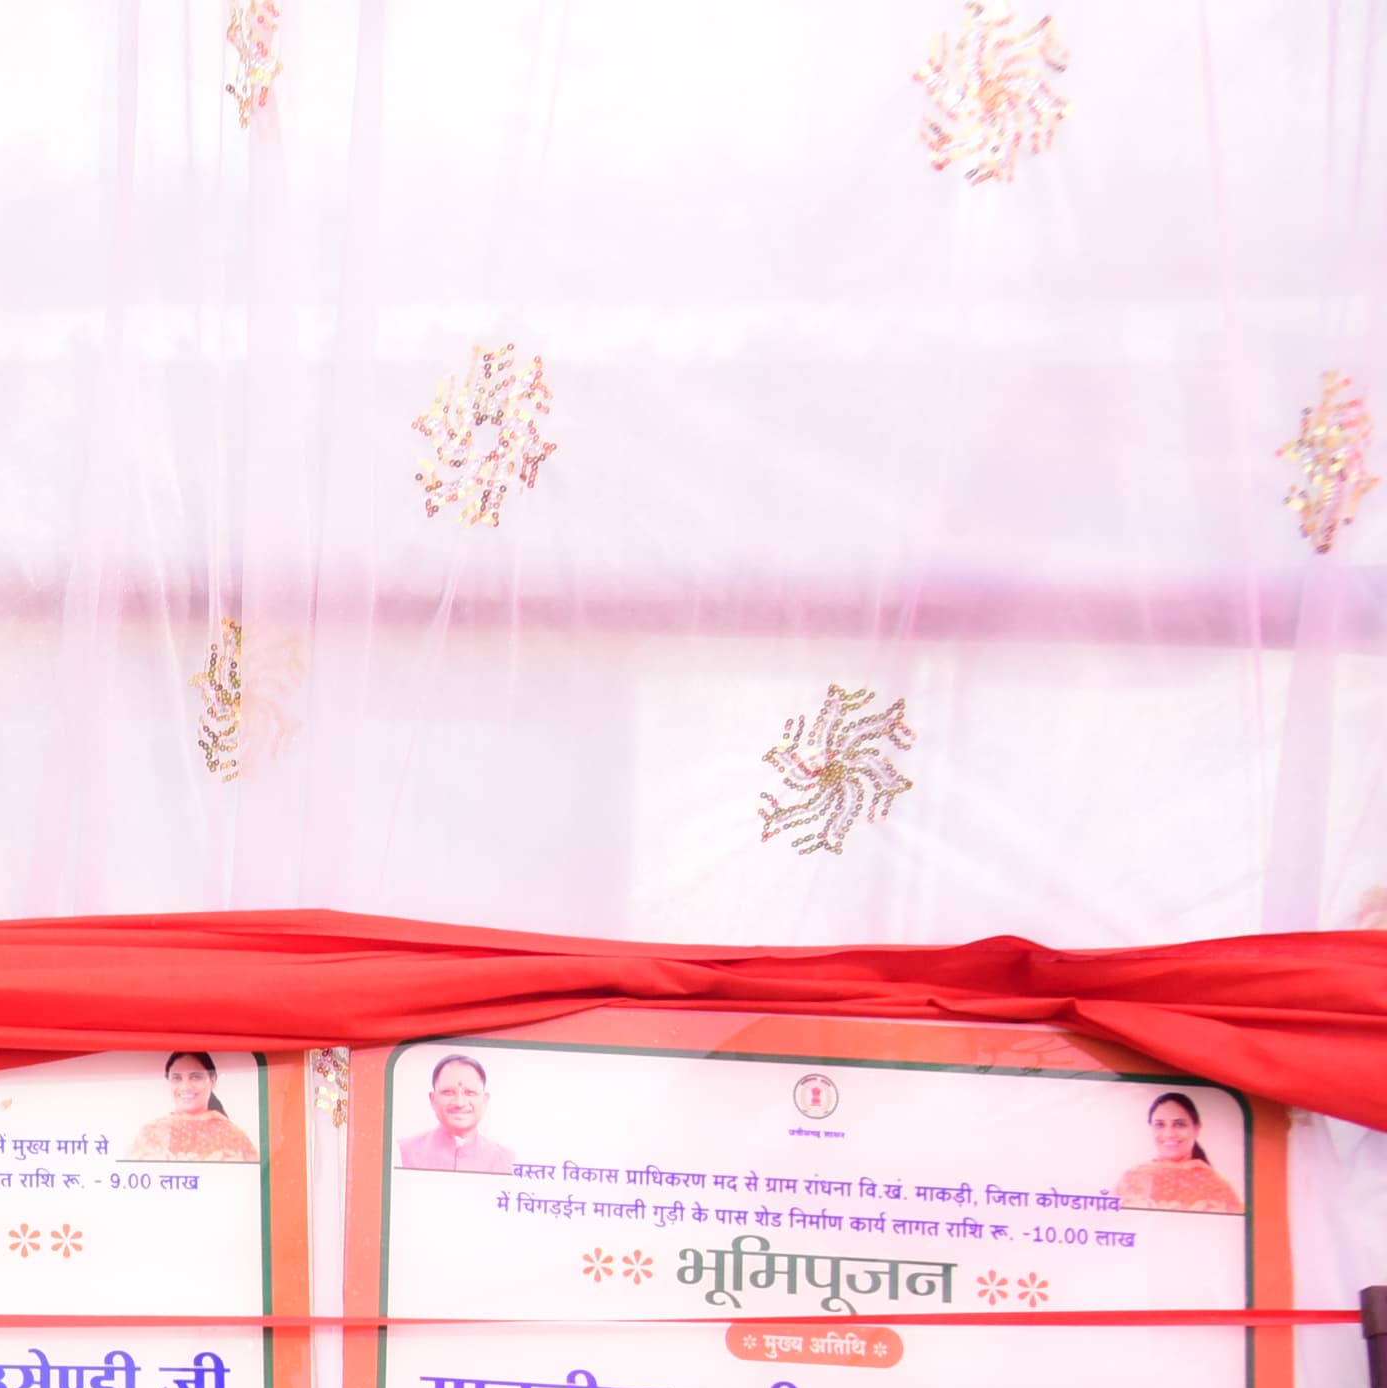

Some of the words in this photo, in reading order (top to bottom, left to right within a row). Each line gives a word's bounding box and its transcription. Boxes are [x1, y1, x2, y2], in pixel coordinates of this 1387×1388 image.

[561, 1160, 619, 1183] विकास
[624, 1164, 707, 1189] प्राधिकरण
[743, 1170, 759, 1192] से
[803, 1174, 853, 1197] रांधना
[984, 1183, 1029, 1207] जिला
[1034, 1185, 1121, 1212] कोण्डागाँव
[676, 1234, 958, 1316] भूमिपूजन
